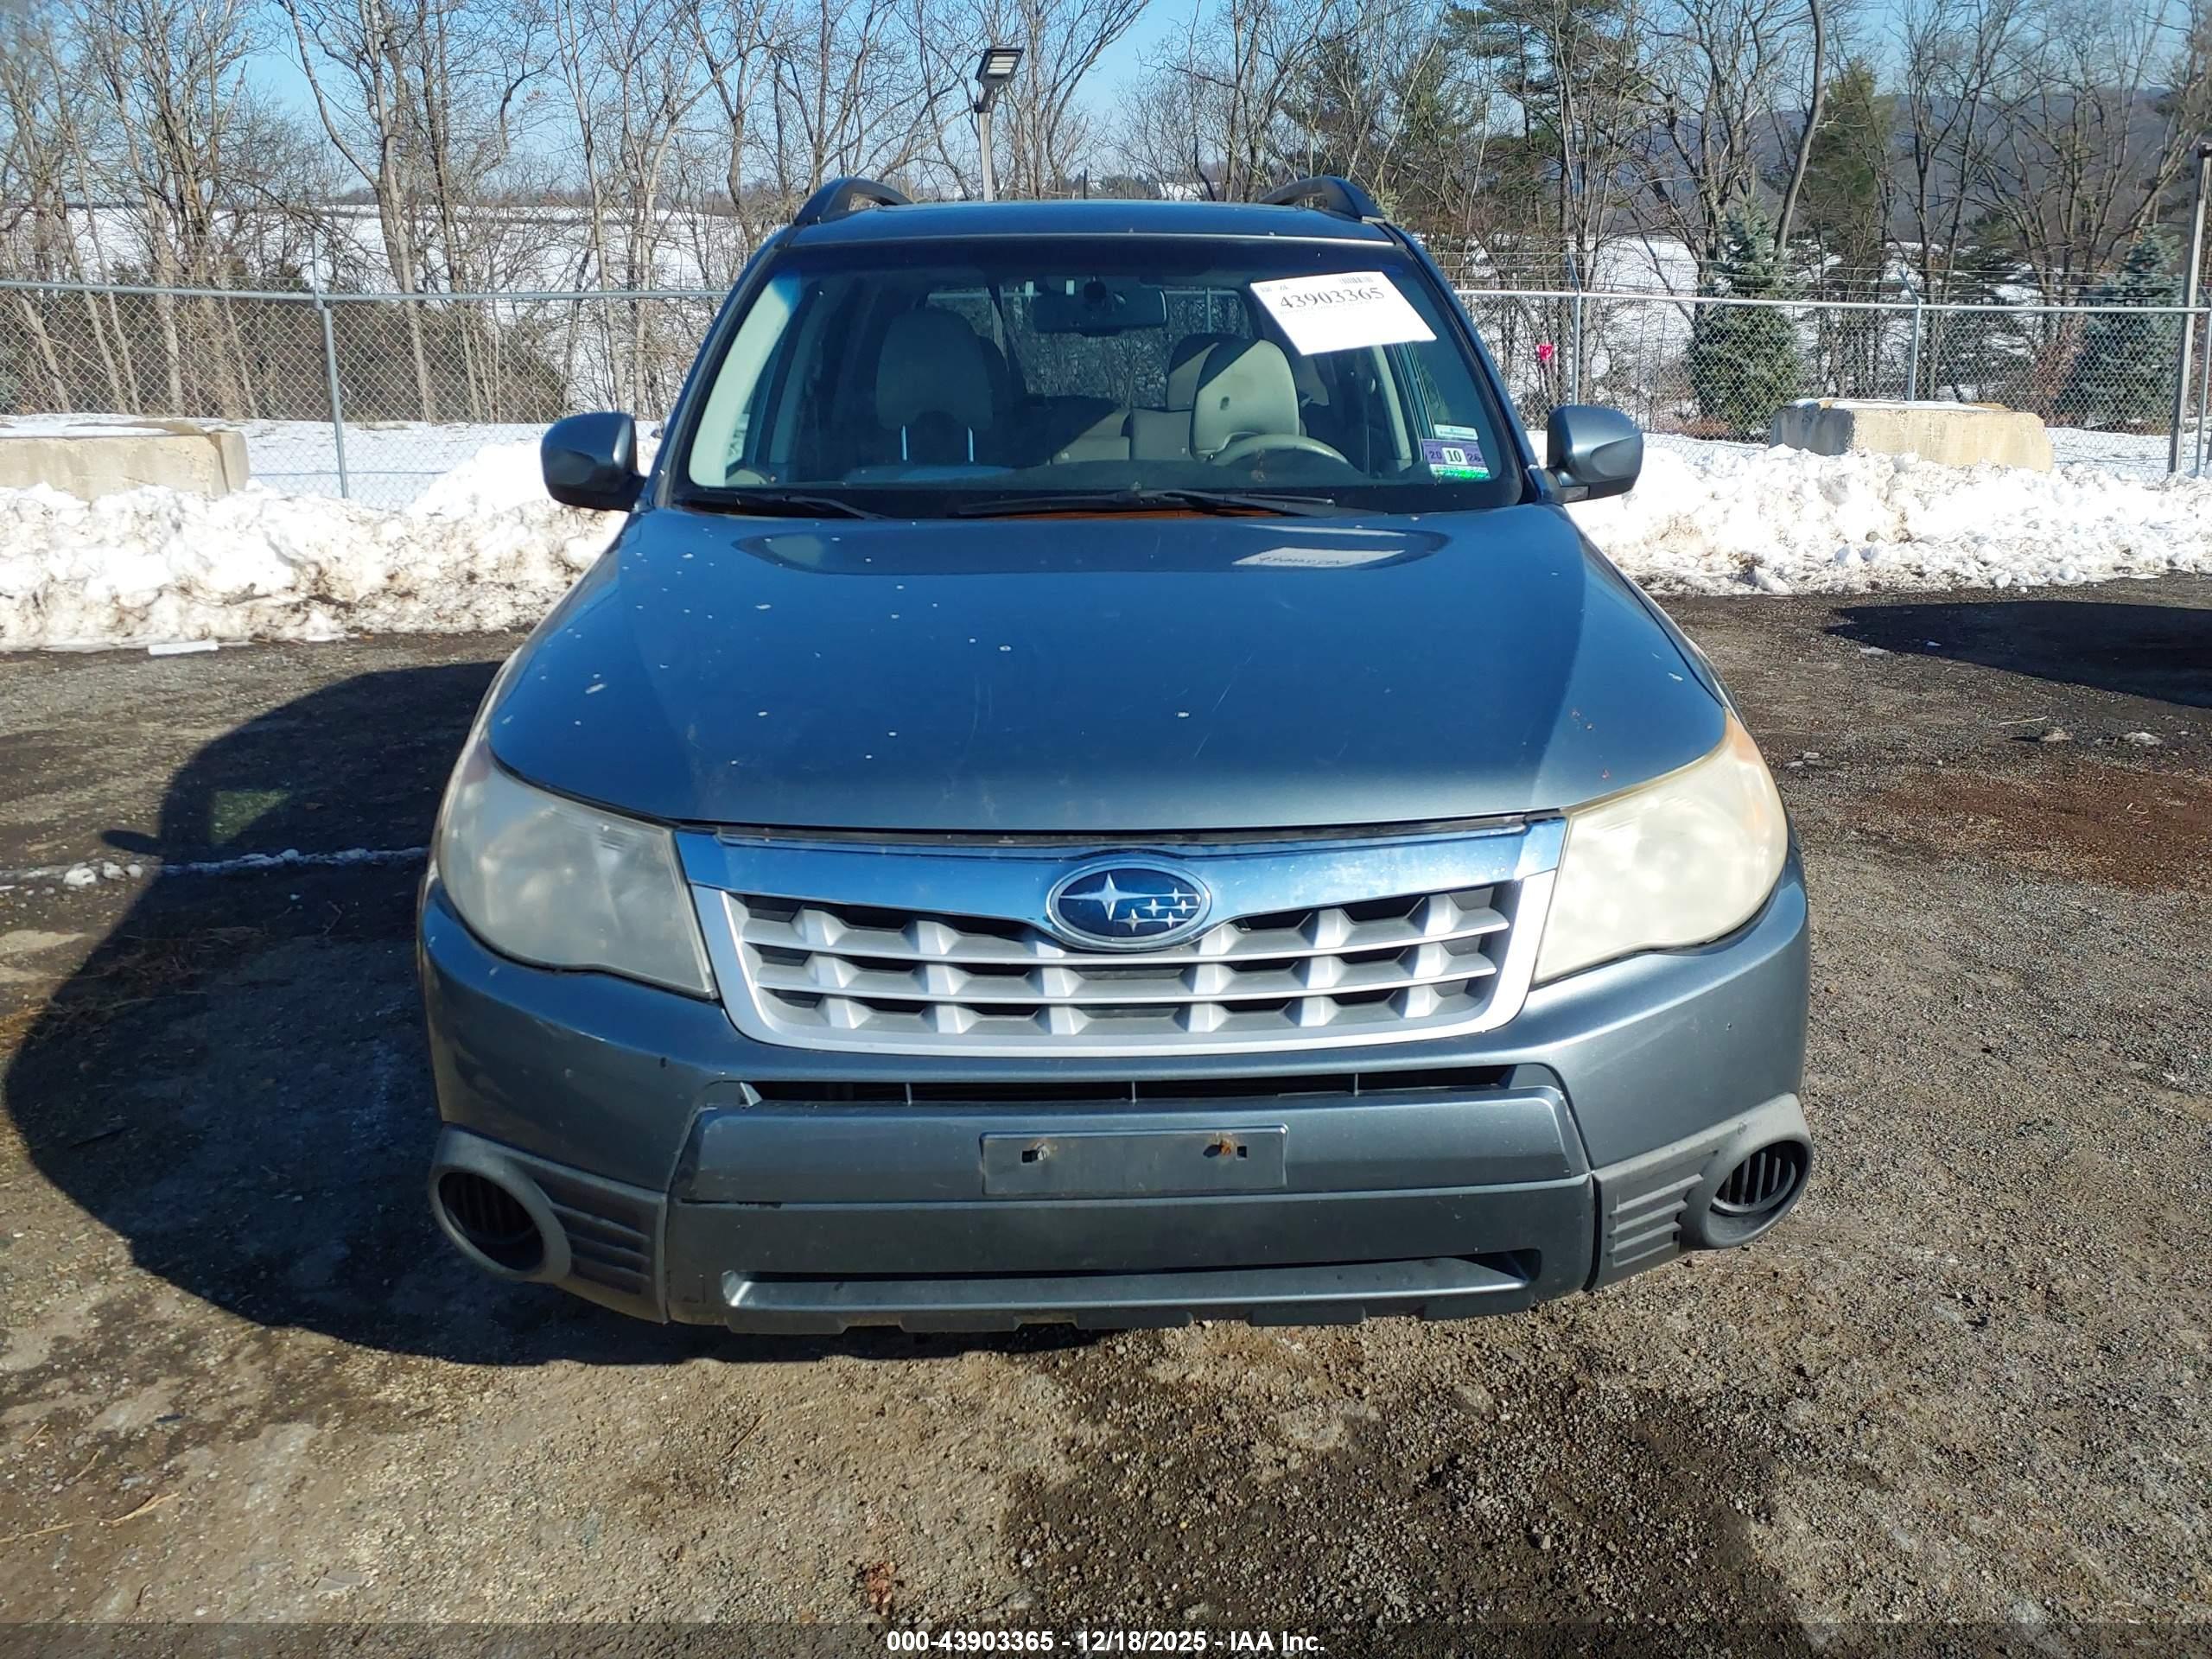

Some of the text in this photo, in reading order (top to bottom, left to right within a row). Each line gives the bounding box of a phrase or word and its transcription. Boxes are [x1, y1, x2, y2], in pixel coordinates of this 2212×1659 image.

[1281, 287, 1384, 308] 43903365
[1429, 450, 1443, 460] 20
[1446, 449, 1462, 462] 10
